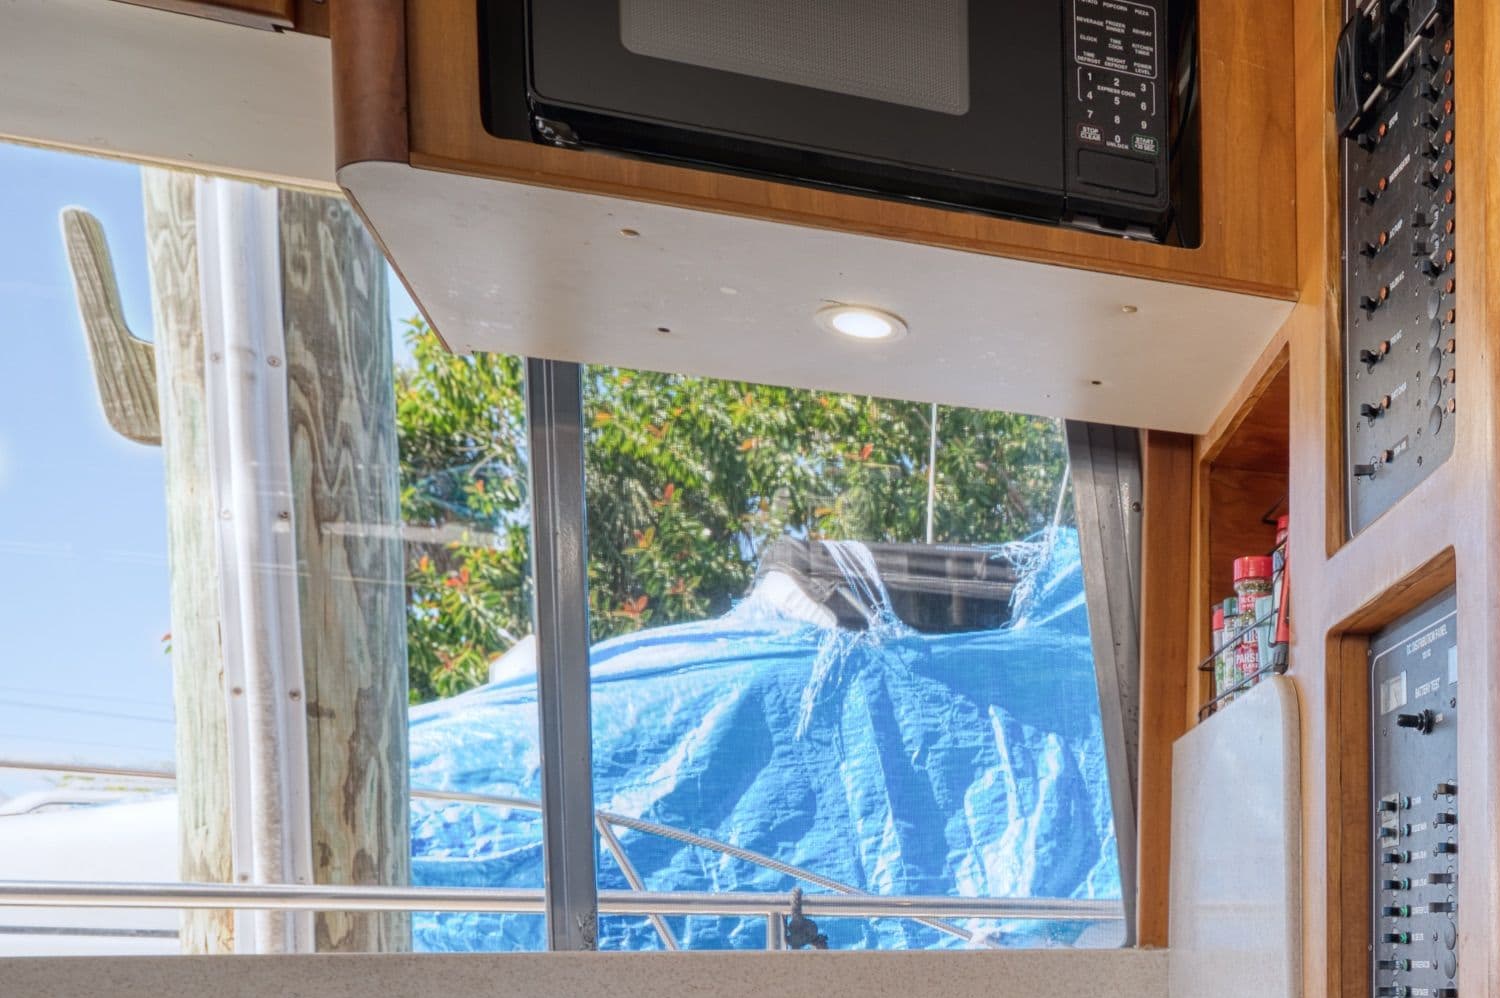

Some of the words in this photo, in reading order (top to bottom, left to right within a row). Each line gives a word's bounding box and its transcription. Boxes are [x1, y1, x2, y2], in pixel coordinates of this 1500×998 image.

[1103, 2, 1128, 11] POPCORN
[1077, 16, 1104, 27] BEVERAGE
[1106, 20, 1126, 29] FROZEN
[1132, 28, 1152, 37] REHEAT
[1080, 34, 1098, 43] CLOCK
[1108, 43, 1124, 51] COOK
[1132, 43, 1153, 52] KITCHEN
[1077, 56, 1101, 65] DEFROST
[1105, 61, 1128, 70] DEFROST
[1133, 62, 1152, 70] POWER
[1135, 68, 1151, 76] LEVEL
[1088, 73, 1092, 81] 1
[1114, 78, 1120, 87] 2
[1097, 85, 1120, 95] EXPRESS
[1121, 90, 1136, 98] COOK
[1140, 83, 1147, 92] 3
[1086, 91, 1093, 100] 4
[1114, 96, 1120, 105] 5
[1141, 102, 1147, 111] 6
[1087, 110, 1093, 119] 7
[1114, 115, 1120, 124] 8
[1082, 126, 1099, 134] STOP
[1141, 121, 1147, 130] 9
[1080, 132, 1101, 141] CLEAR
[1114, 134, 1121, 143] 0
[1136, 136, 1153, 145] START
